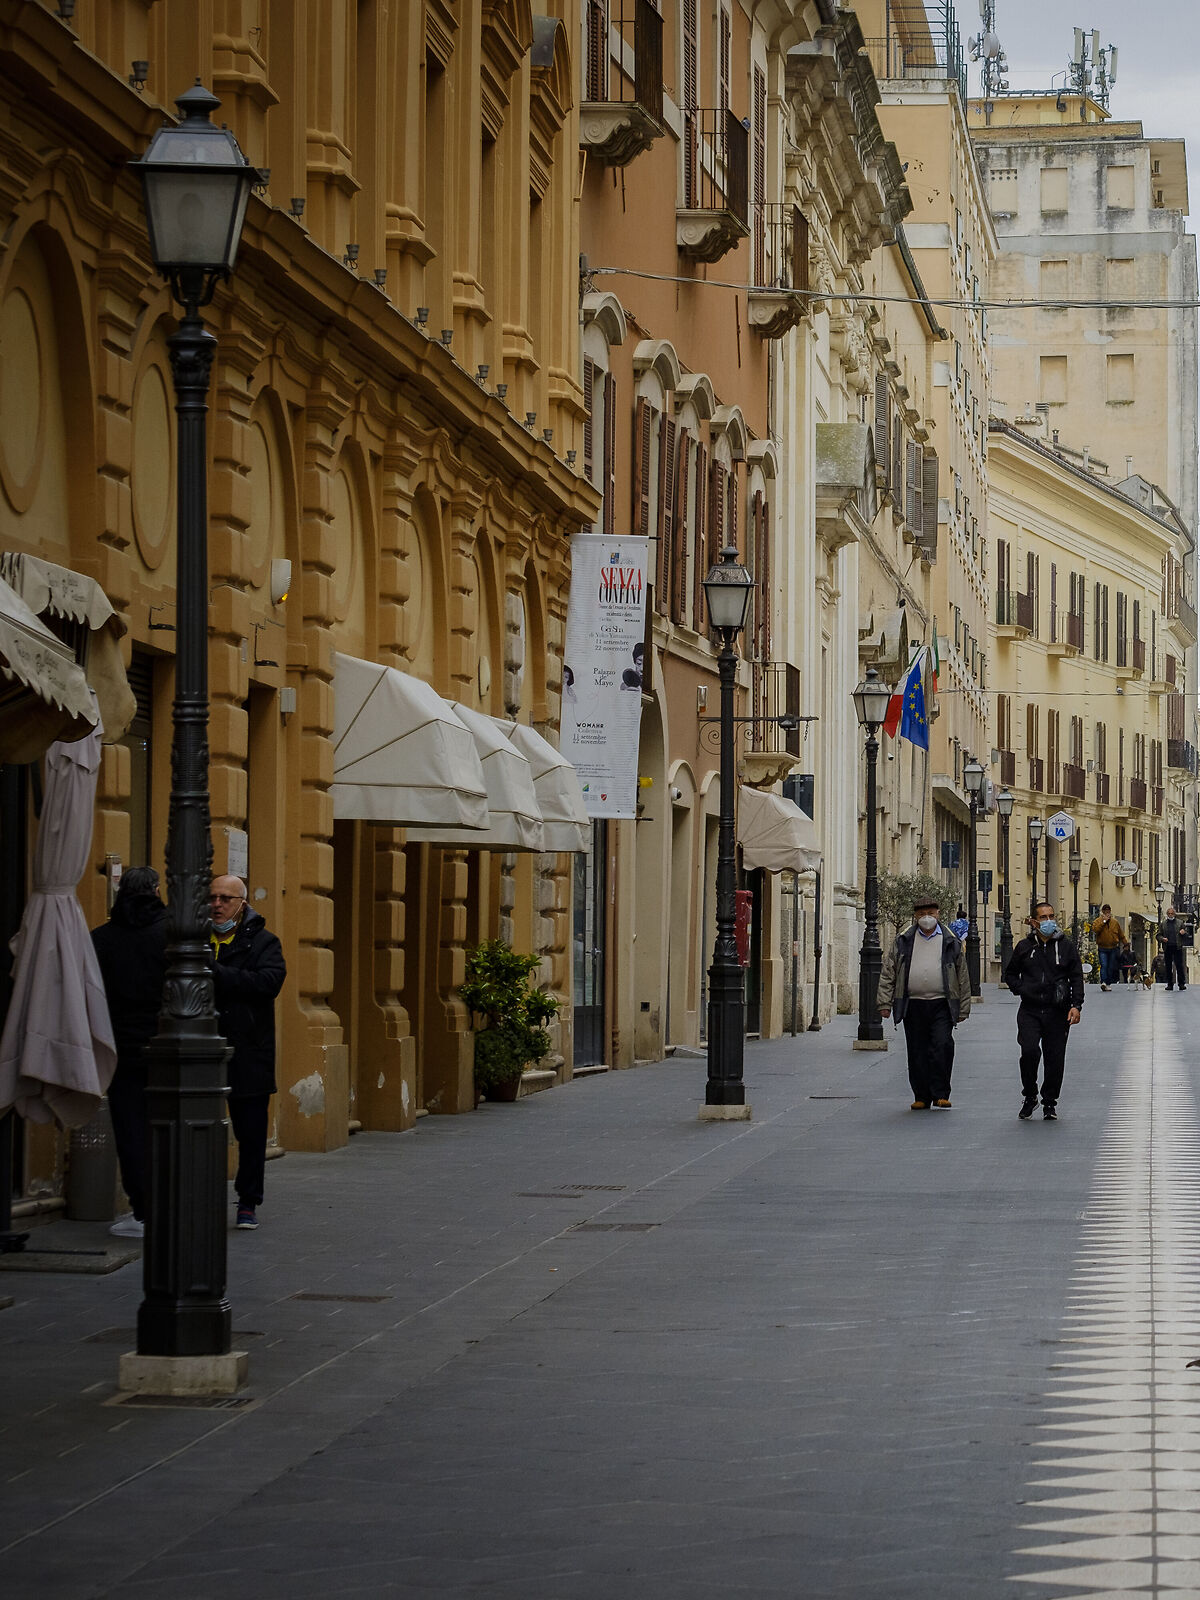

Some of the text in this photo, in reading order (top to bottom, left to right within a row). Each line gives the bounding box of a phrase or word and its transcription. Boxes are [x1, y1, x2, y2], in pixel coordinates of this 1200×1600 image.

[601, 567, 642, 590] SENZA
[599, 583, 642, 604] CONFINI
[594, 679, 614, 688] Mayo
